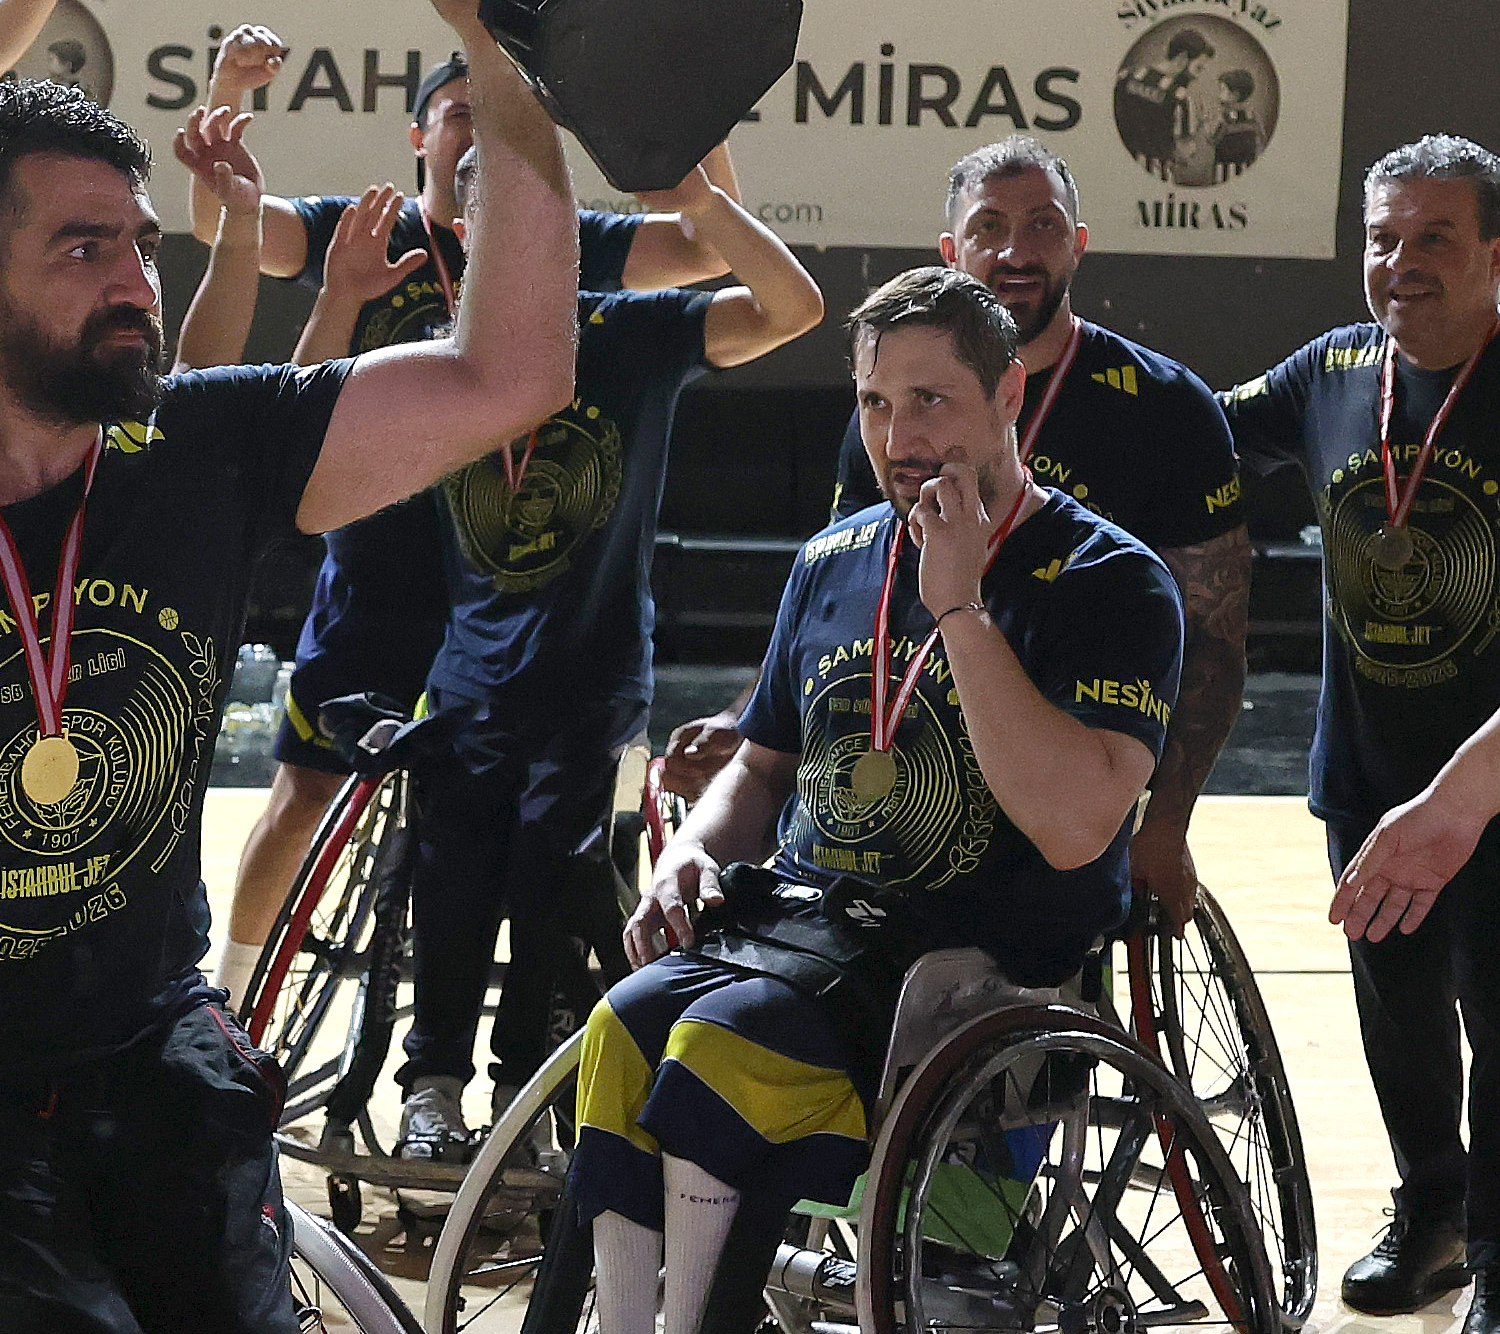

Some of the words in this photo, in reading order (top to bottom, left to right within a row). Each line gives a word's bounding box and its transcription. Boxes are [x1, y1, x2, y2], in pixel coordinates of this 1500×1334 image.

[795, 43, 1084, 134] MİRAS
[1347, 443, 1483, 480] ŞAMPYON
[1206, 471, 1241, 515] NES
[41, 827, 80, 849] 1907
[0, 861, 82, 900] İSTANBUL
